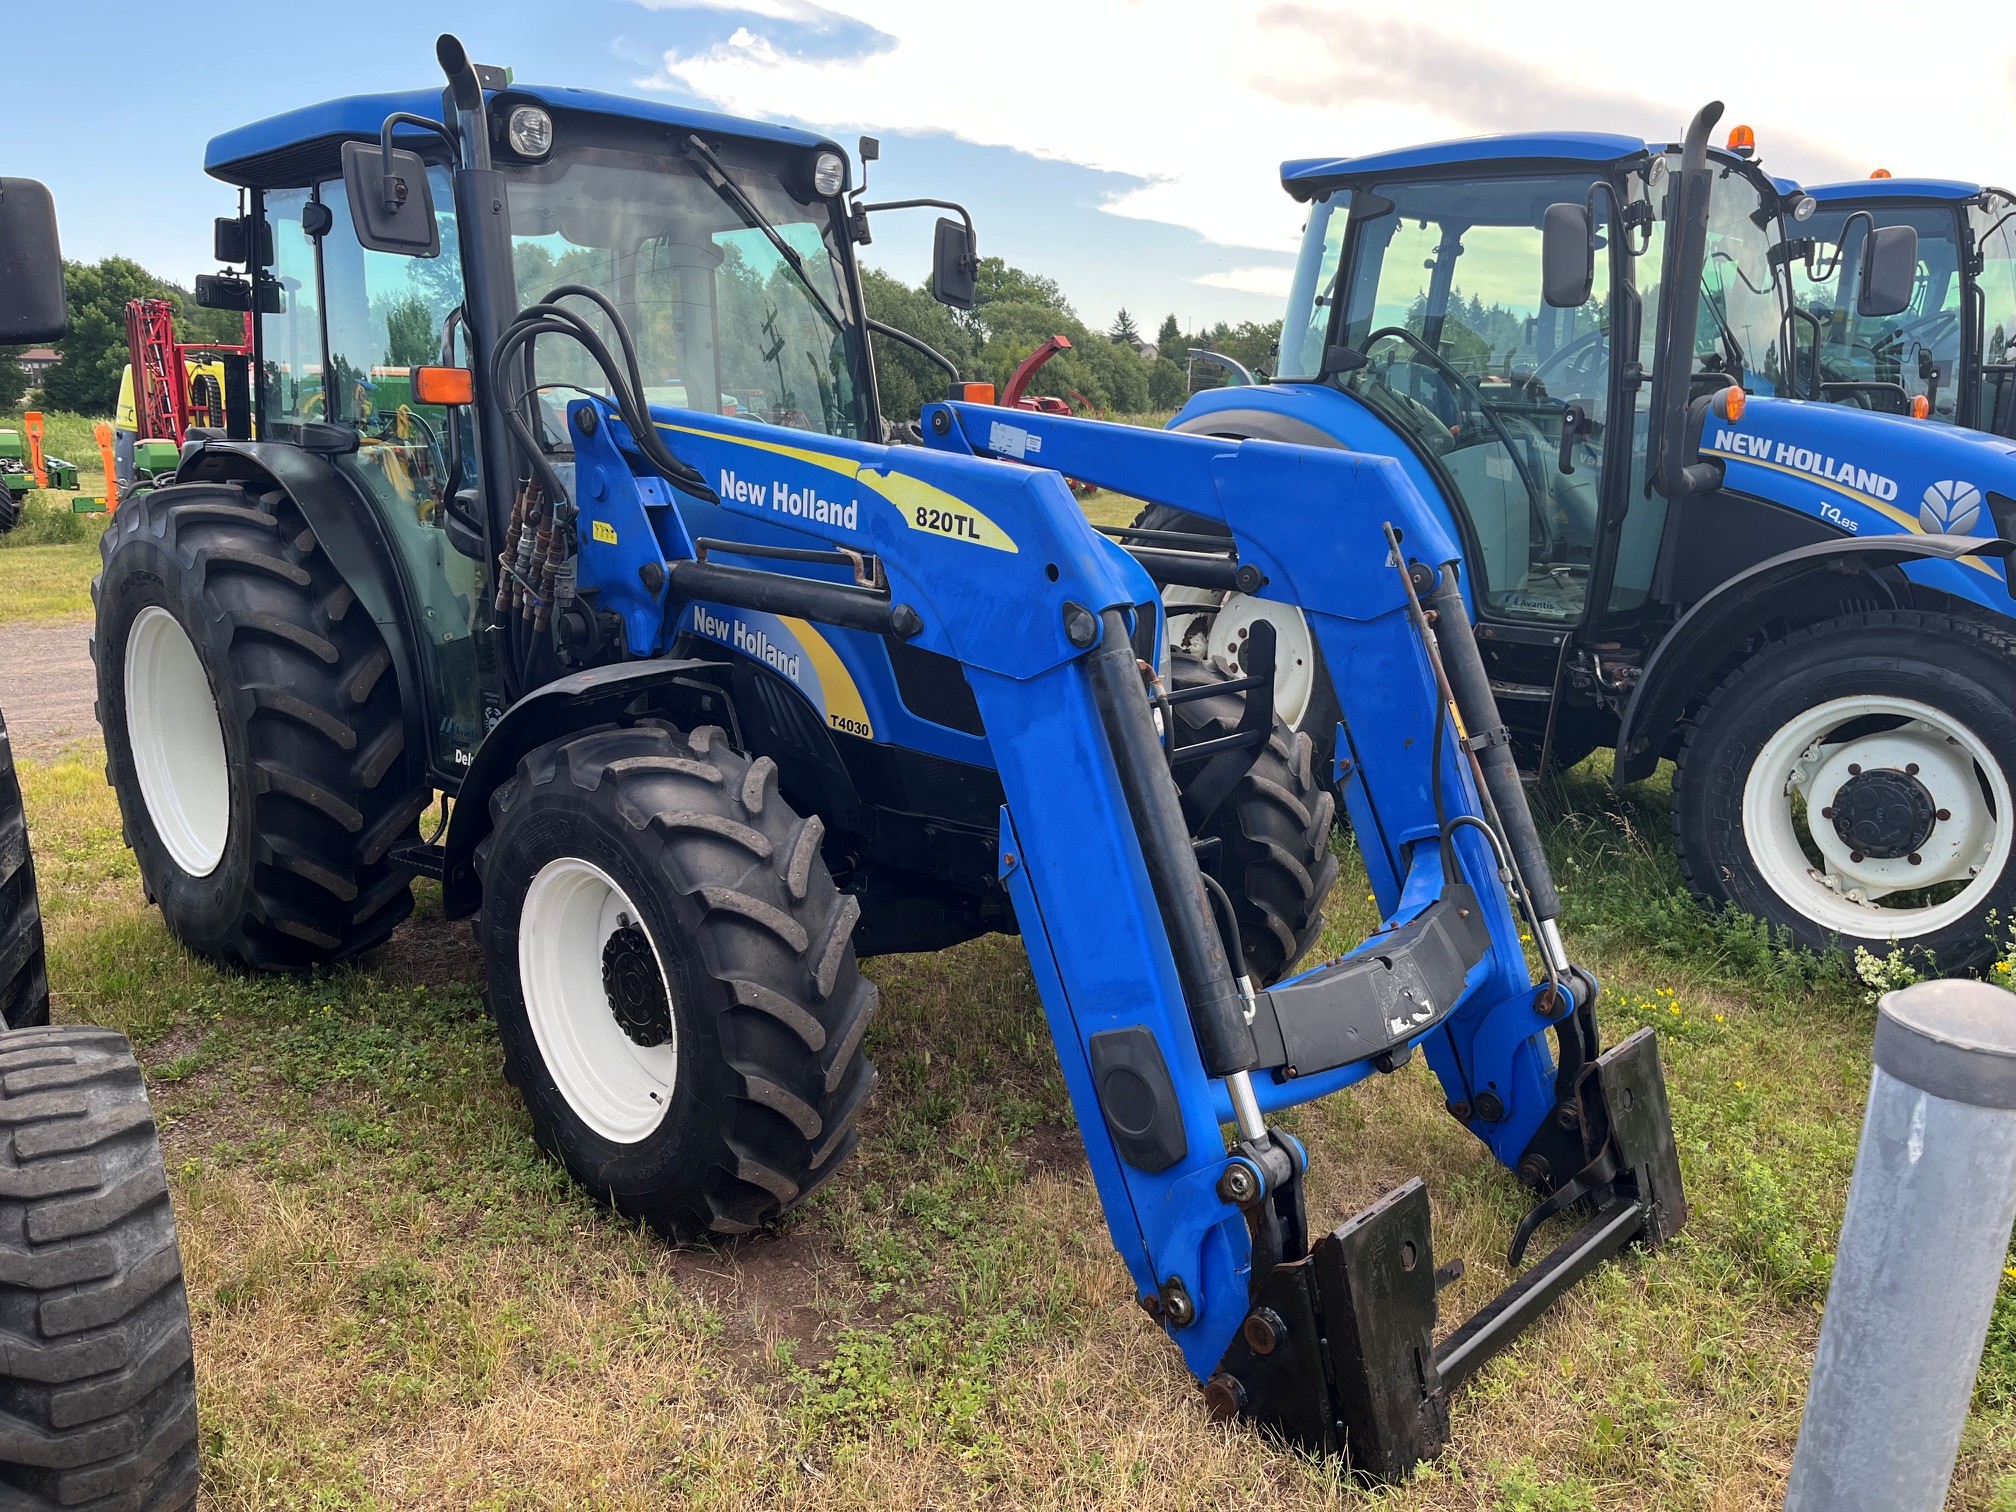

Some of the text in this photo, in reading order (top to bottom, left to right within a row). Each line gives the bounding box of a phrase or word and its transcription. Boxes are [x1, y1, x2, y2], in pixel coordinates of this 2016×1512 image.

[1714, 429, 1898, 502] NEW HOLLAND
[720, 469, 858, 531] New Holland
[1820, 501, 1859, 532] T4.85
[916, 506, 980, 540] 820TL
[1520, 599, 1555, 610] Avantis
[693, 605, 800, 684] New Holland
[830, 714, 870, 737] T4030
